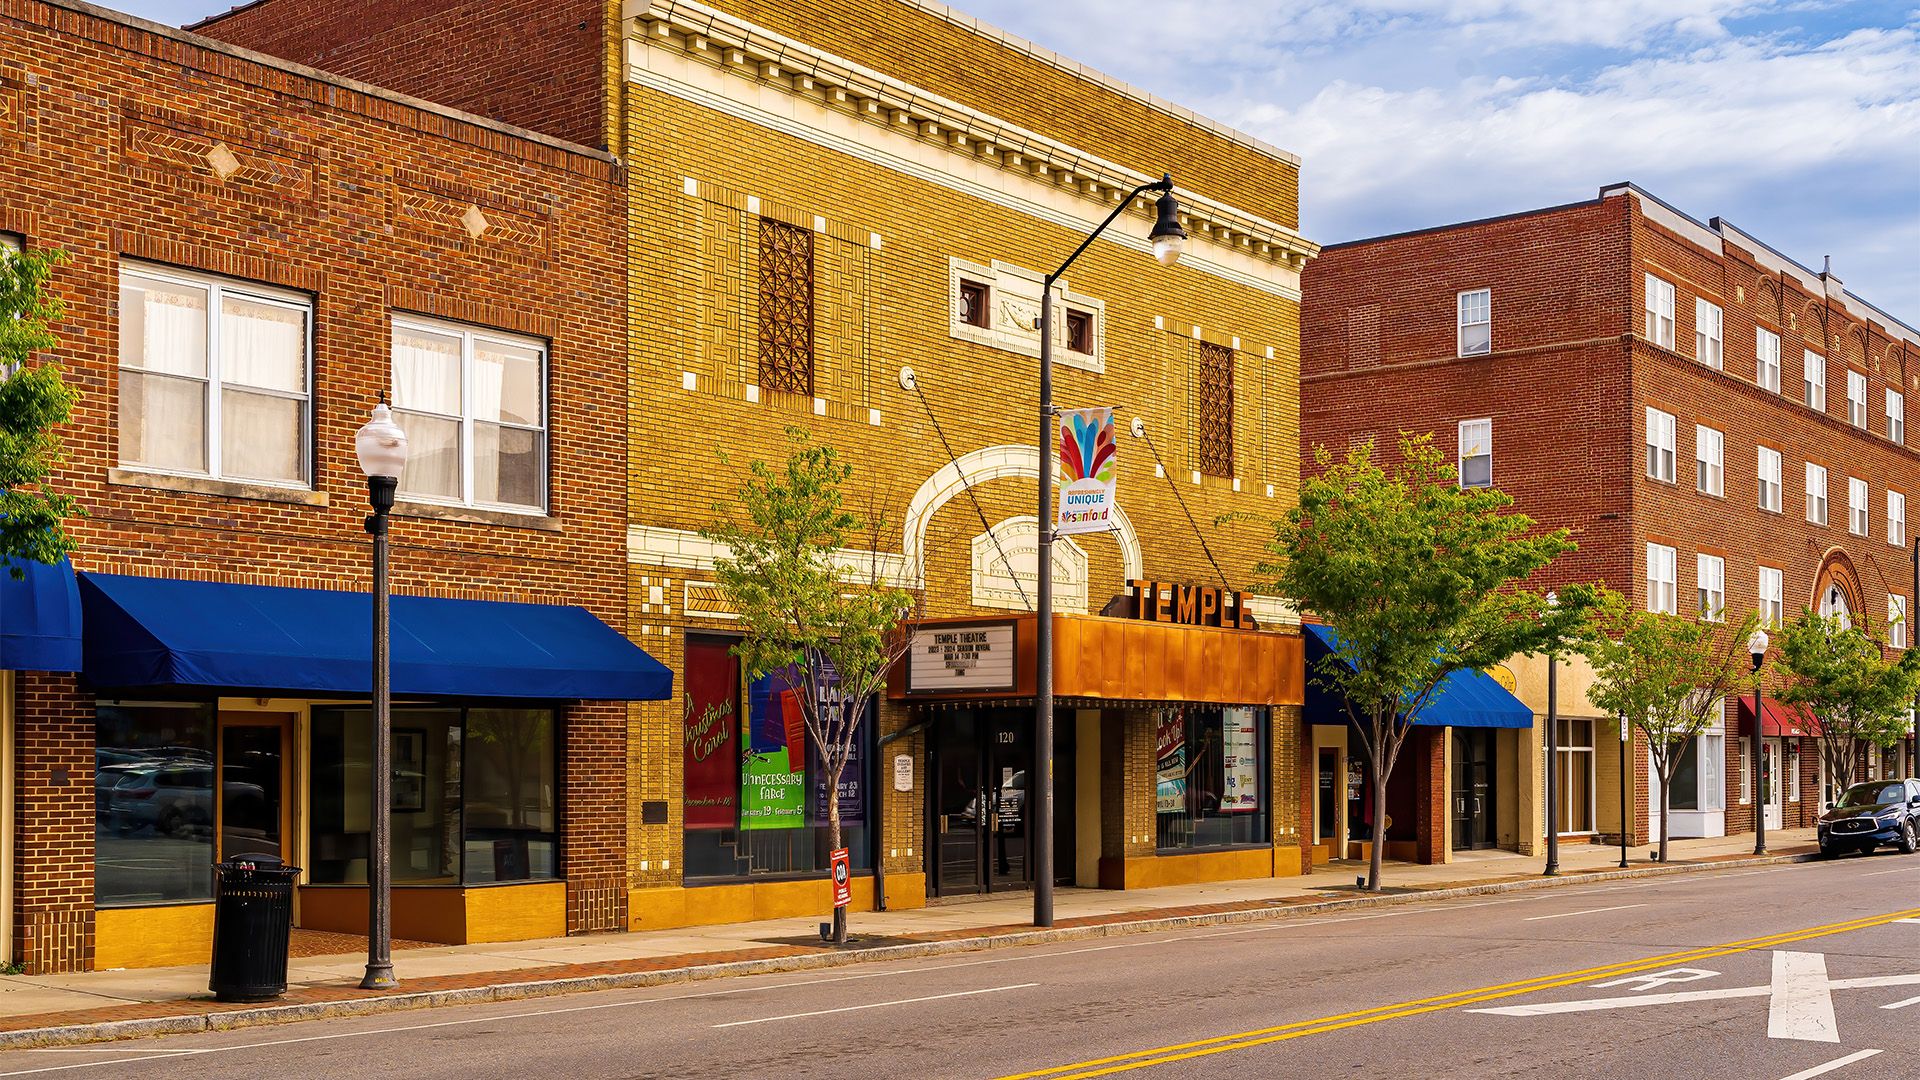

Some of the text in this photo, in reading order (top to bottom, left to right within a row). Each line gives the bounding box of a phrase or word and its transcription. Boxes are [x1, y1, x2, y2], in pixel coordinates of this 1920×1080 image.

[1067, 494, 1104, 505] UNIQUE
[1071, 507, 1109, 522] sanford
[1127, 579, 1254, 630] TEMPLE
[934, 632, 987, 644] TEMPLE THEATRE
[928, 645, 940, 653] 2023
[944, 645, 955, 653] 2024
[957, 644, 974, 652] SEASON
[975, 644, 991, 652] REVEAL
[684, 698, 733, 746] hristmas
[693, 721, 730, 763] Carol
[999, 732, 1014, 743] 120
[848, 781, 858, 790] 23
[763, 805, 772, 816] 19
[796, 804, 803, 815] 5
